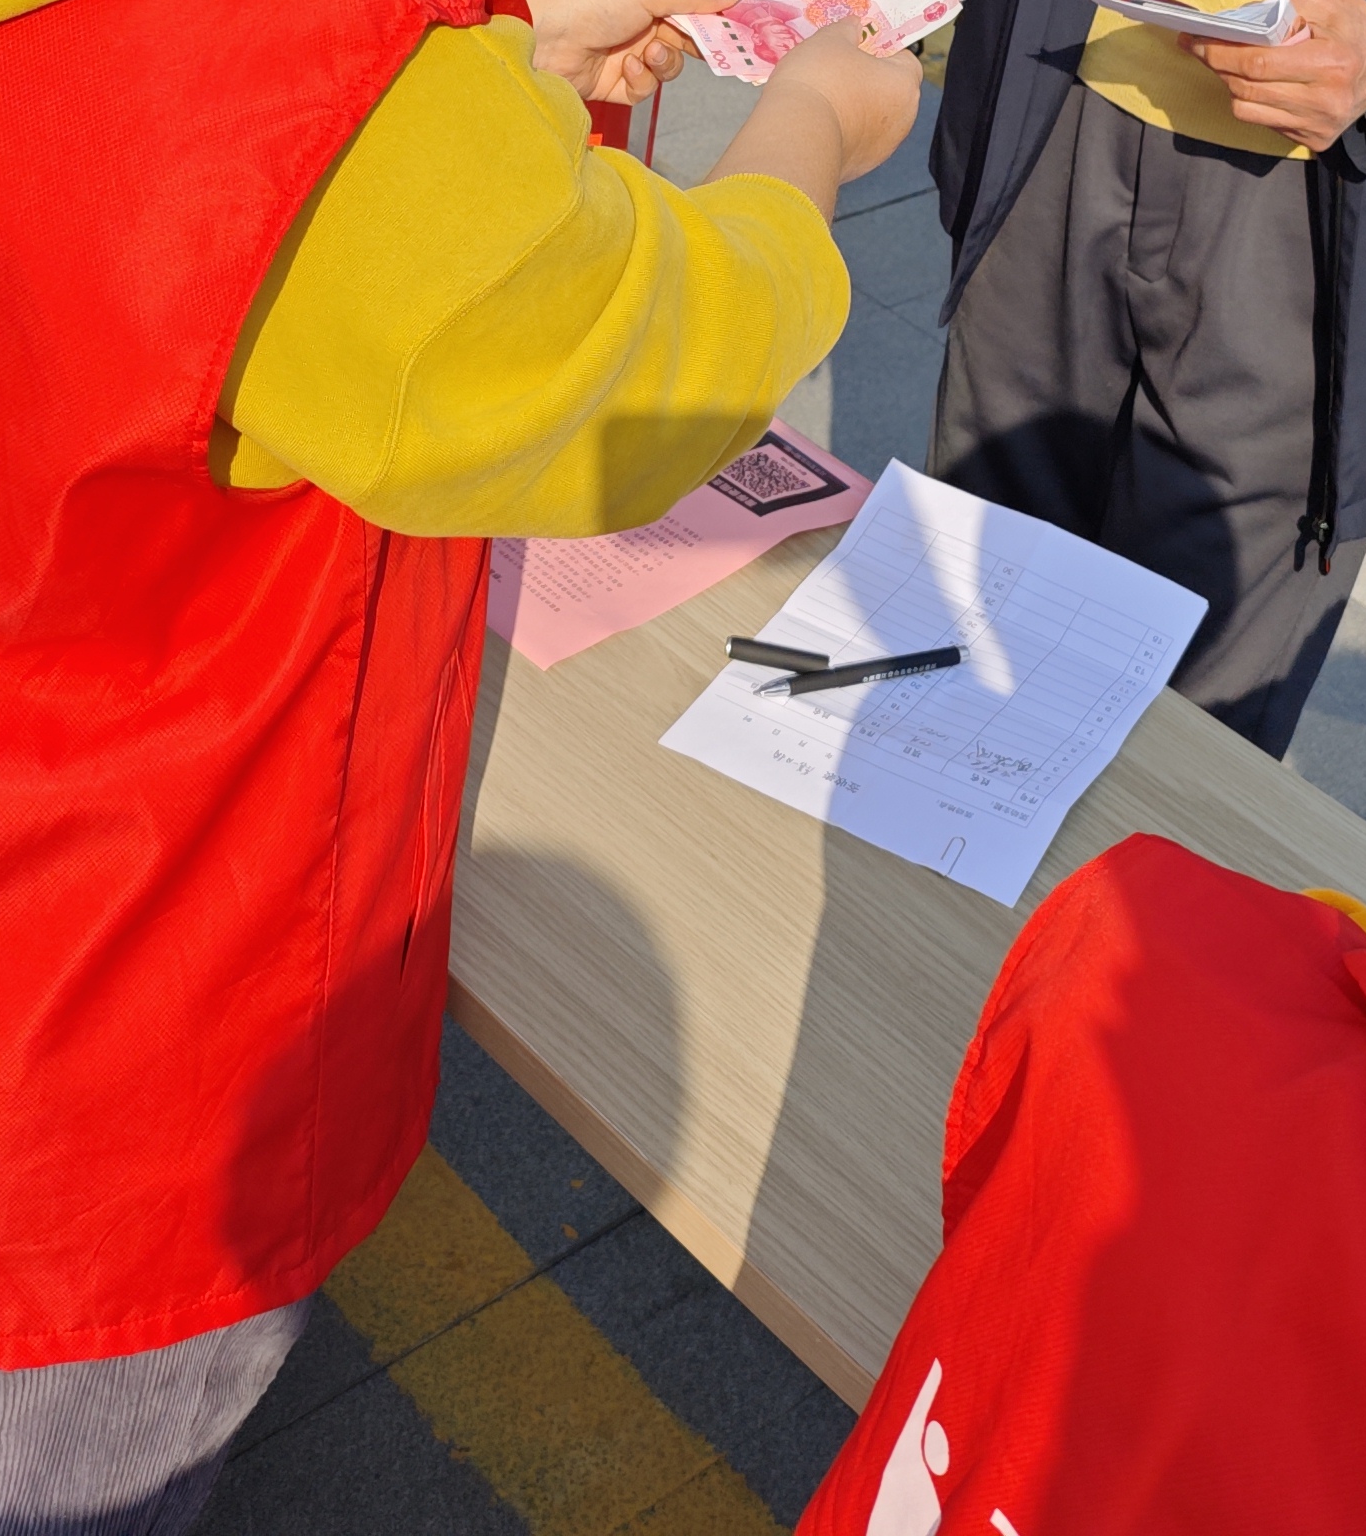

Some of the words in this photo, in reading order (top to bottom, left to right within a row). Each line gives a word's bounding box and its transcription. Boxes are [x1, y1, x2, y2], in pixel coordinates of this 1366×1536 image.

[709, 48, 732, 70] 100
[1002, 565, 1015, 576] 30
[993, 581, 1005, 591] 29
[984, 596, 996, 607] 28
[1143, 650, 1154, 660] 14
[1134, 665, 1146, 676] 13
[909, 681, 923, 690] 20
[821, 769, 862, 795] 签收表
